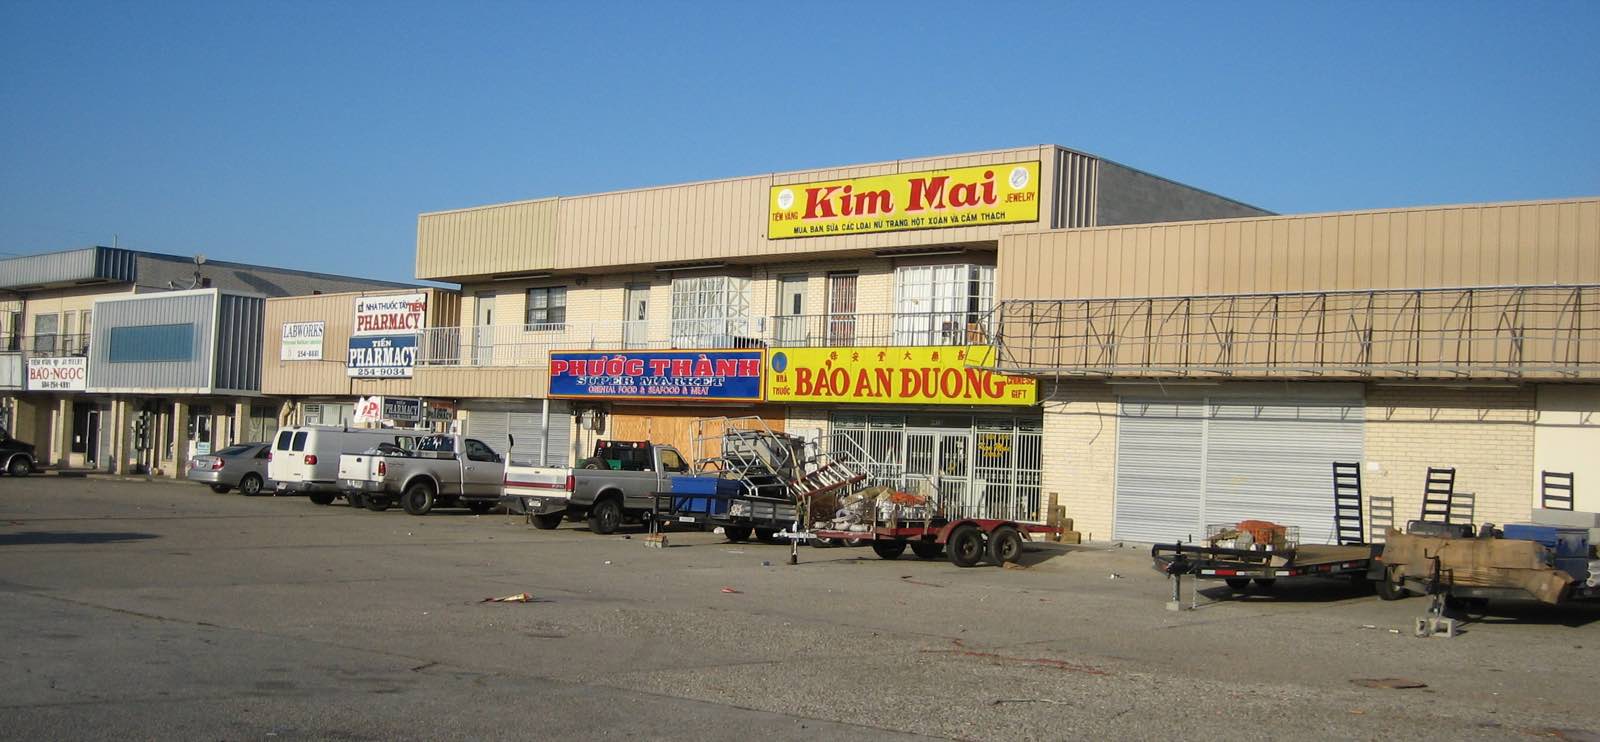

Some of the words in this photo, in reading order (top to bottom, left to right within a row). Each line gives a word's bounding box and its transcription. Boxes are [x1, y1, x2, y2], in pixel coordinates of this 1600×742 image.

[801, 184, 894, 220] Kim
[904, 170, 998, 212] Mai
[1005, 191, 1036, 203] JEWELRY
[793, 226, 808, 235] MUA
[356, 312, 421, 331] PHARMACY
[283, 323, 323, 338] LABWORKS
[348, 346, 418, 367] PHARMACY
[358, 368, 406, 376] 254-9034
[550, 354, 644, 377] PHƯỚC
[575, 376, 635, 386] SUPER
[639, 376, 726, 387] MARKET
[853, 367, 894, 398] AN
[588, 385, 616, 394] ORIENTAL
[617, 385, 638, 394] FOOD
[647, 385, 681, 395] SEAFOOD
[690, 386, 710, 396] MEAT
[1011, 389, 1027, 399] GIFT
